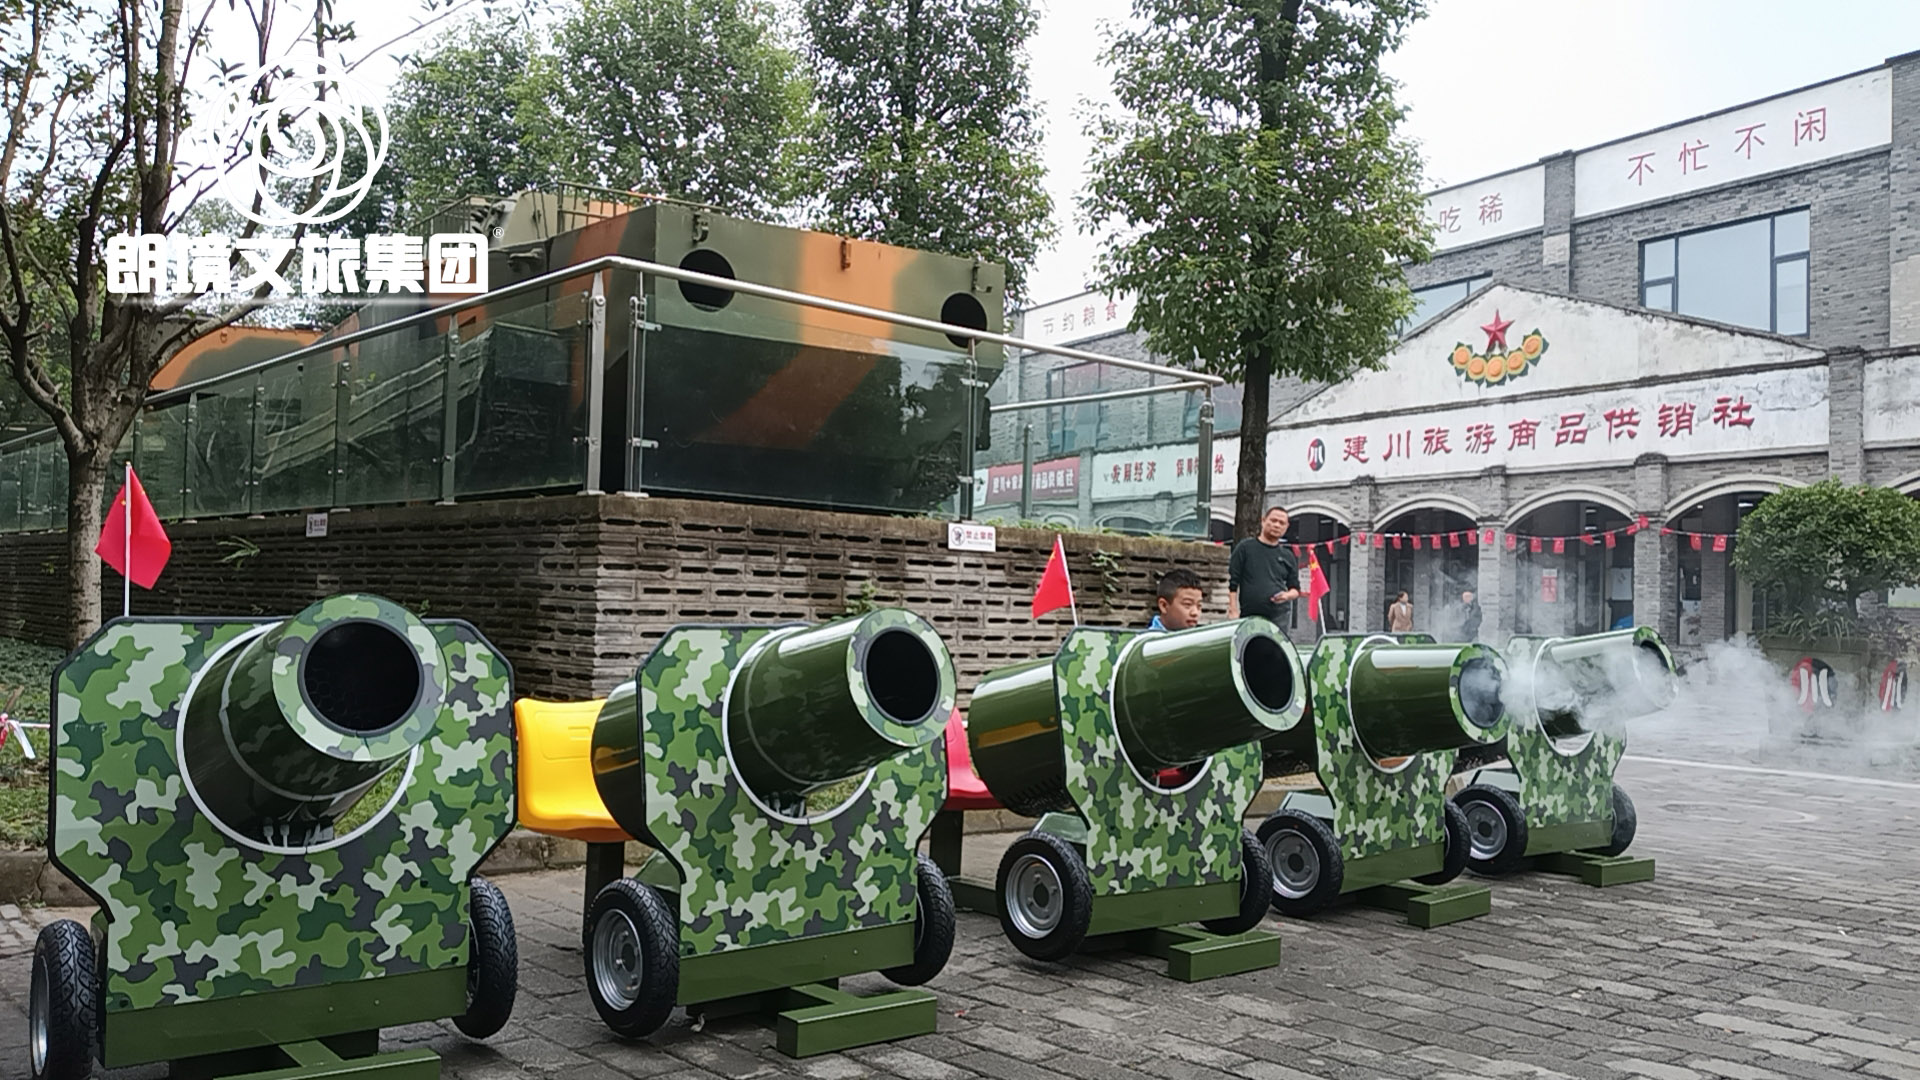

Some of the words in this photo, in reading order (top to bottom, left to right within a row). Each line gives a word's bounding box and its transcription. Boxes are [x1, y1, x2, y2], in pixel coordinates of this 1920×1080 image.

[1627, 107, 1827, 187] 不忙不闲
[1342, 395, 1756, 464] 建川旅游商品供销社
